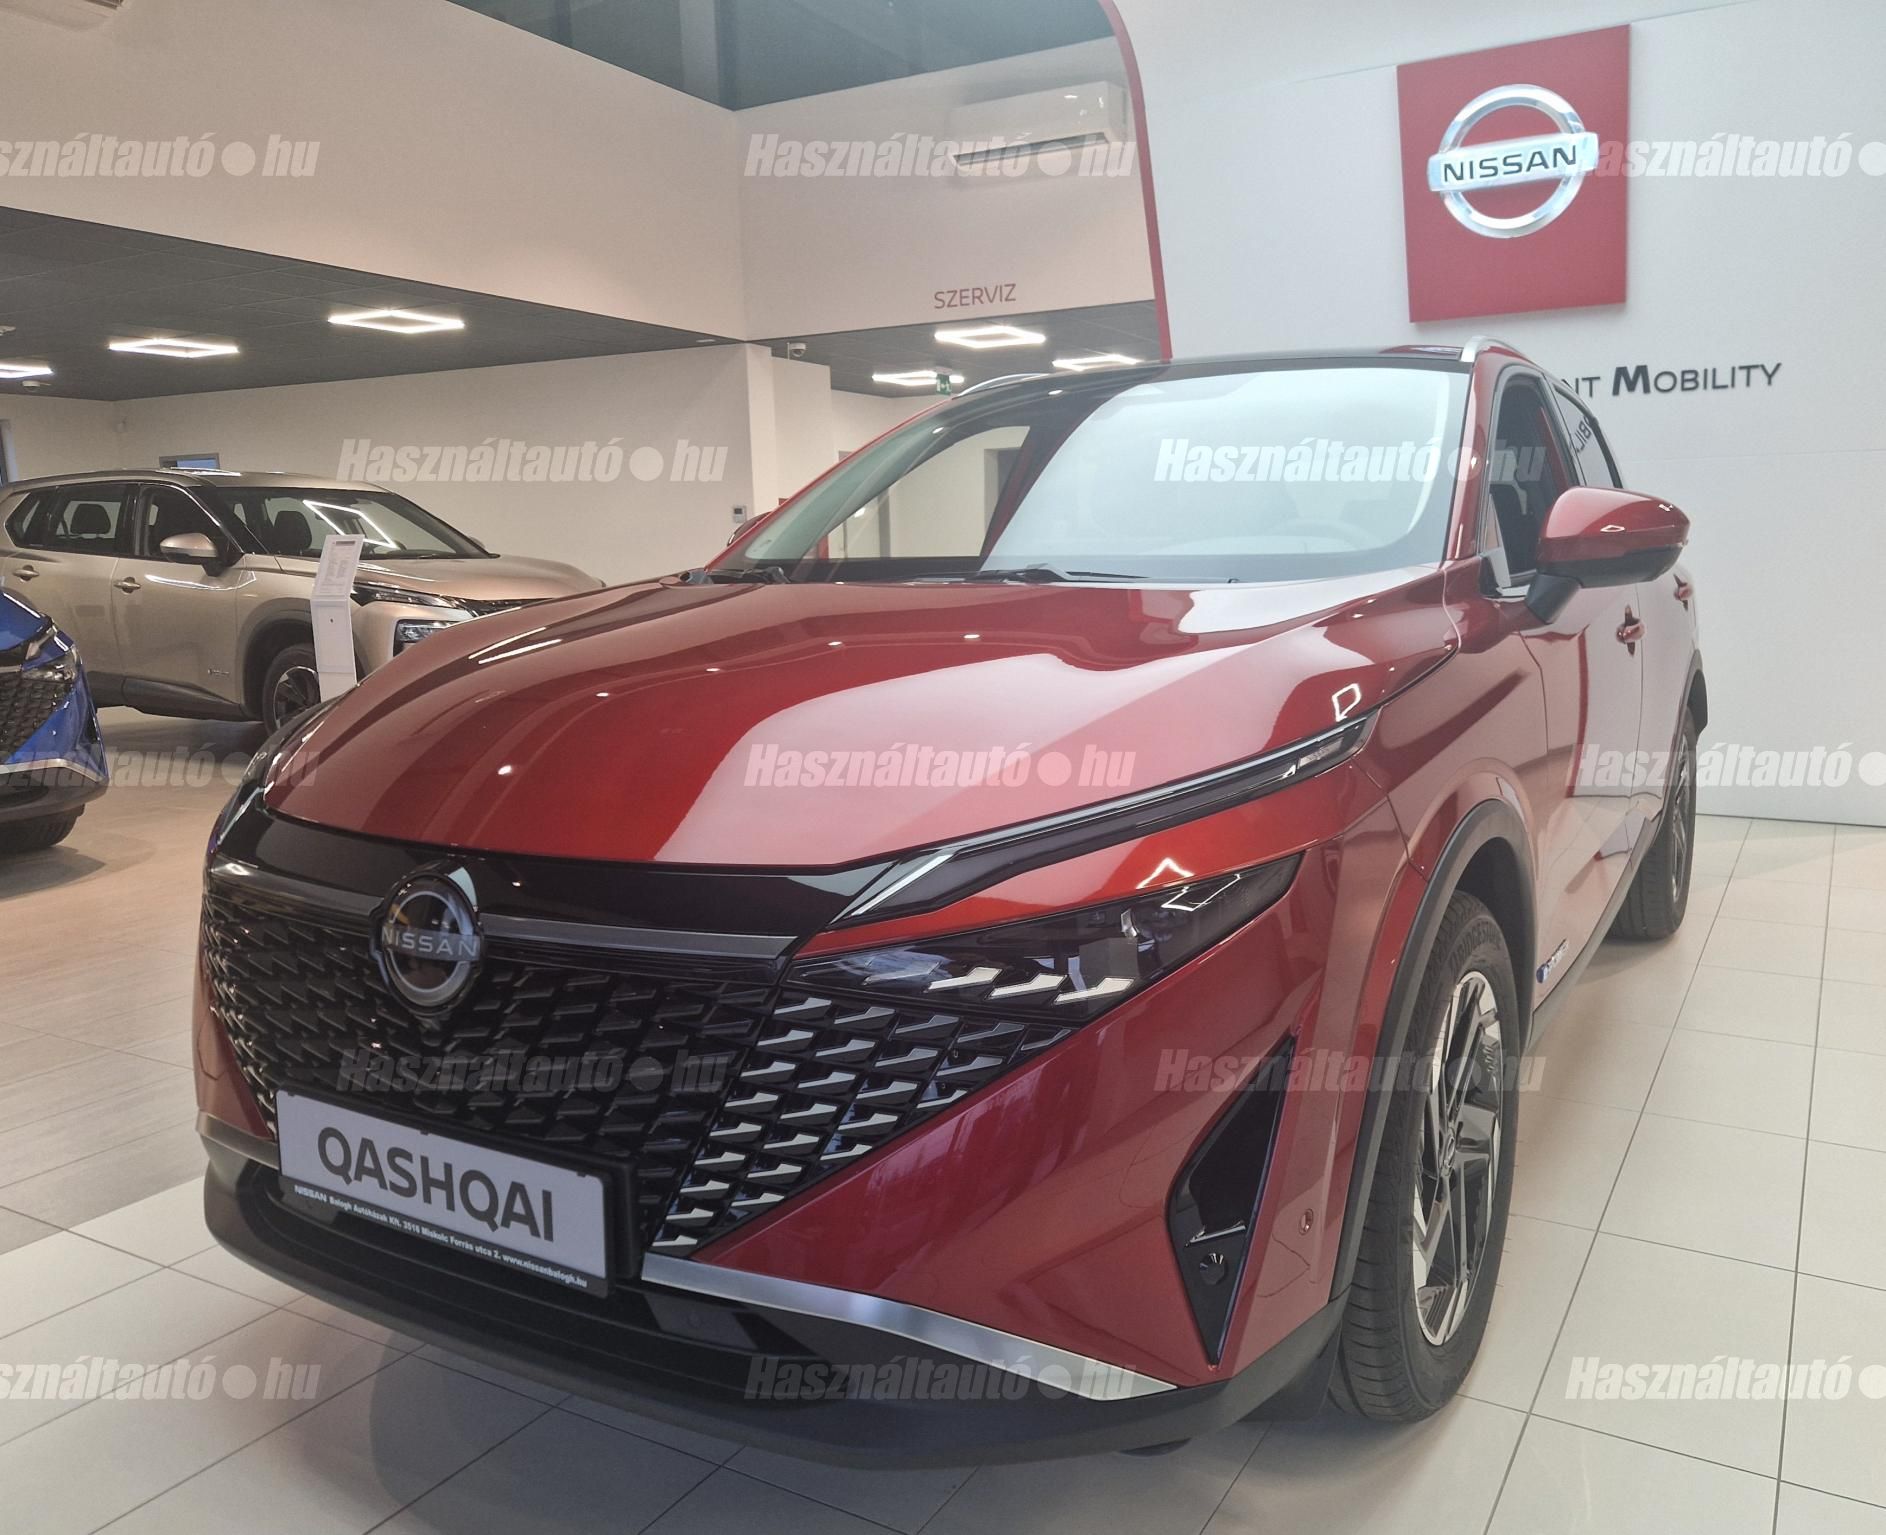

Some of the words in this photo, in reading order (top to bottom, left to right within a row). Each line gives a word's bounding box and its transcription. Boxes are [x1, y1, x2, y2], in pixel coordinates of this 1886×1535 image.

[1444, 144, 1577, 182] NISSAN
[933, 283, 1017, 309] SZERVIZ
[1612, 363, 1782, 396] MOBILITY
[381, 925, 478, 957] NISSAN
[316, 1126, 554, 1243] QASHQAI
[294, 1185, 327, 1202] NISSAN
[329, 1196, 352, 1211] Balogh
[421, 1226, 449, 1243] Miskolc
